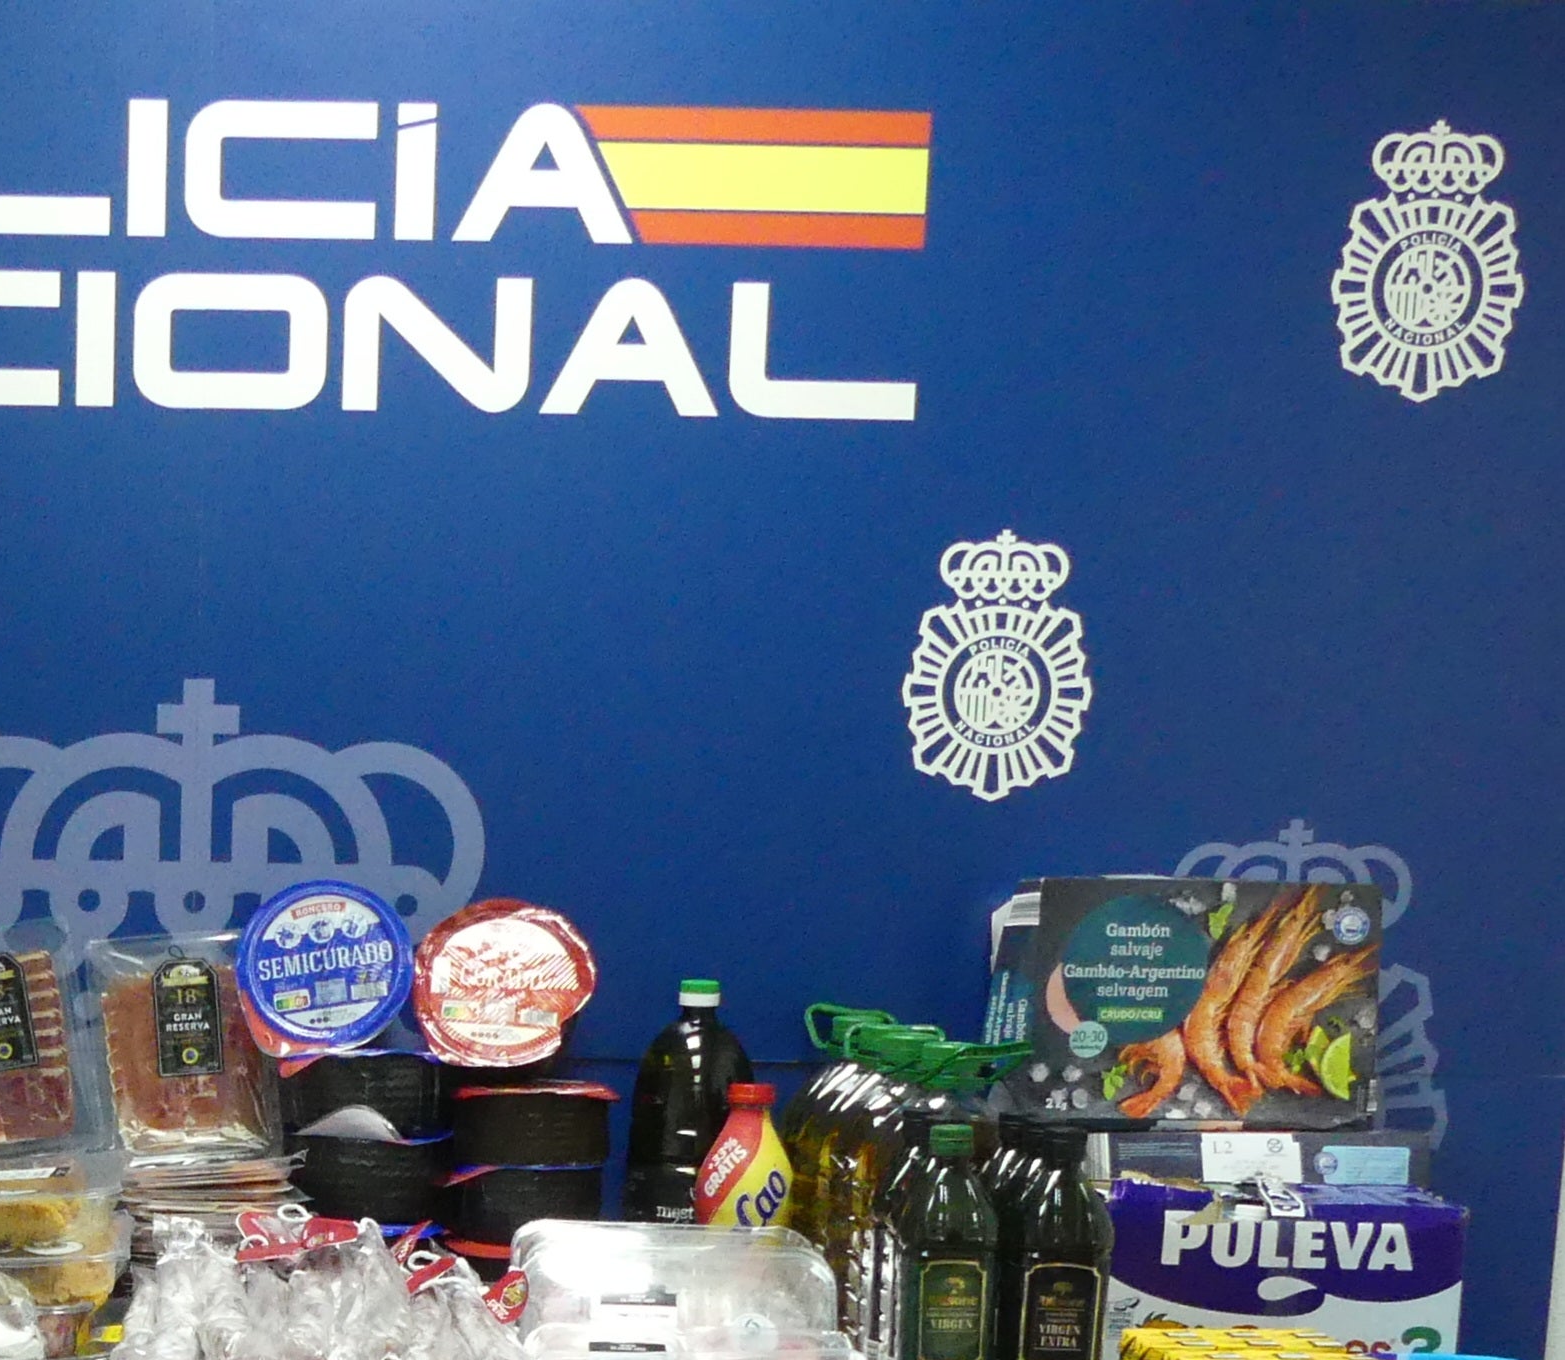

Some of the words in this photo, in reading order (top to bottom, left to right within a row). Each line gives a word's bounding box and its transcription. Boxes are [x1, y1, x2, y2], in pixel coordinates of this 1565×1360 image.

[1399, 232, 1463, 254] POLICÍA
[1383, 318, 1467, 345] NACIONAL
[968, 636, 1031, 659] POLICÍA
[953, 720, 1036, 747] NACIONAL
[295, 902, 342, 918] RONCERO
[1105, 922, 1171, 938] Gambón
[1110, 941, 1164, 960] salvaje
[258, 940, 394, 982] SEMICURADO
[1064, 963, 1205, 983] Gambão-Argentino
[177, 988, 197, 1004] 18
[1096, 982, 1169, 1001] selvagem
[173, 1012, 202, 1021] GRAN
[1099, 1009, 1163, 1020] CRUDO/CRU
[166, 1022, 210, 1032] RESERVA
[1072, 1030, 1105, 1042] 20-30
[704, 1143, 749, 1198] GRATIS
[1160, 1209, 1415, 1272] PULEVA
[930, 1318, 973, 1329] VIRGEN
[1039, 1324, 1081, 1336] VIRGEN
[1040, 1335, 1078, 1348] EXTRA
